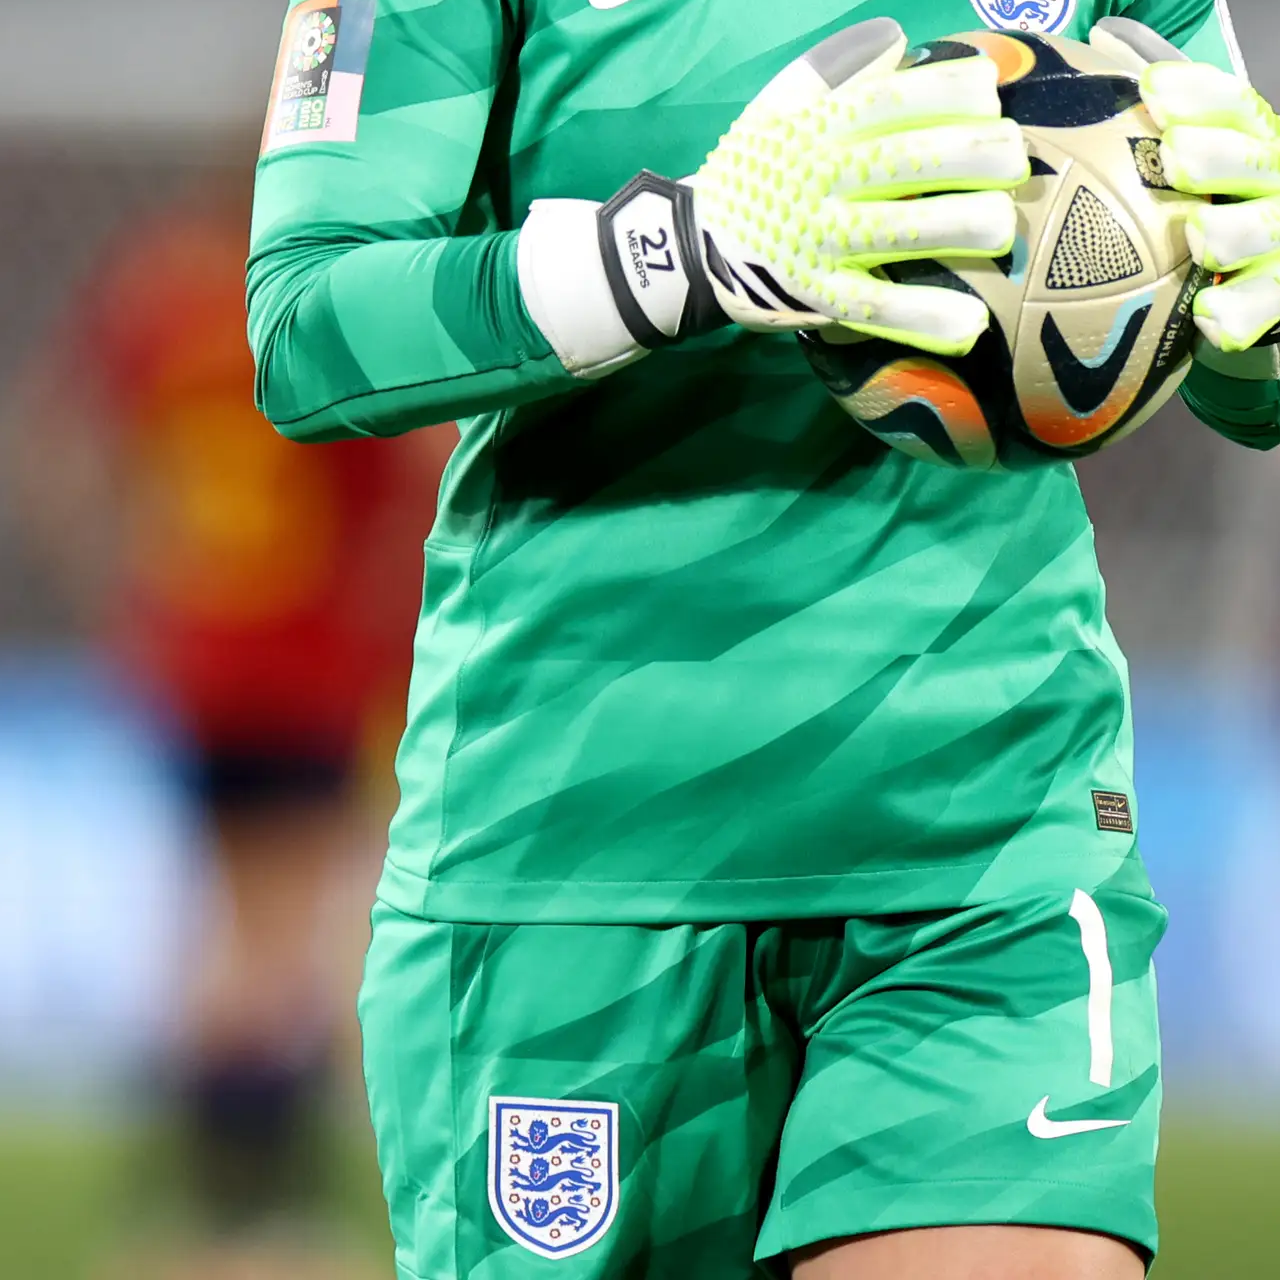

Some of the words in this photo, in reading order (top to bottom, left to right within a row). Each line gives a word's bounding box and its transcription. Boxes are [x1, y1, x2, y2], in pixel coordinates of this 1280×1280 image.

[300, 99, 324, 114] 20
[303, 86, 318, 96] CUP
[298, 113, 322, 128] 23
[626, 229, 650, 289] MEARPS
[640, 227, 675, 271] 27
[1156, 320, 1181, 368] FINAL
[1068, 887, 1113, 1088] 1
